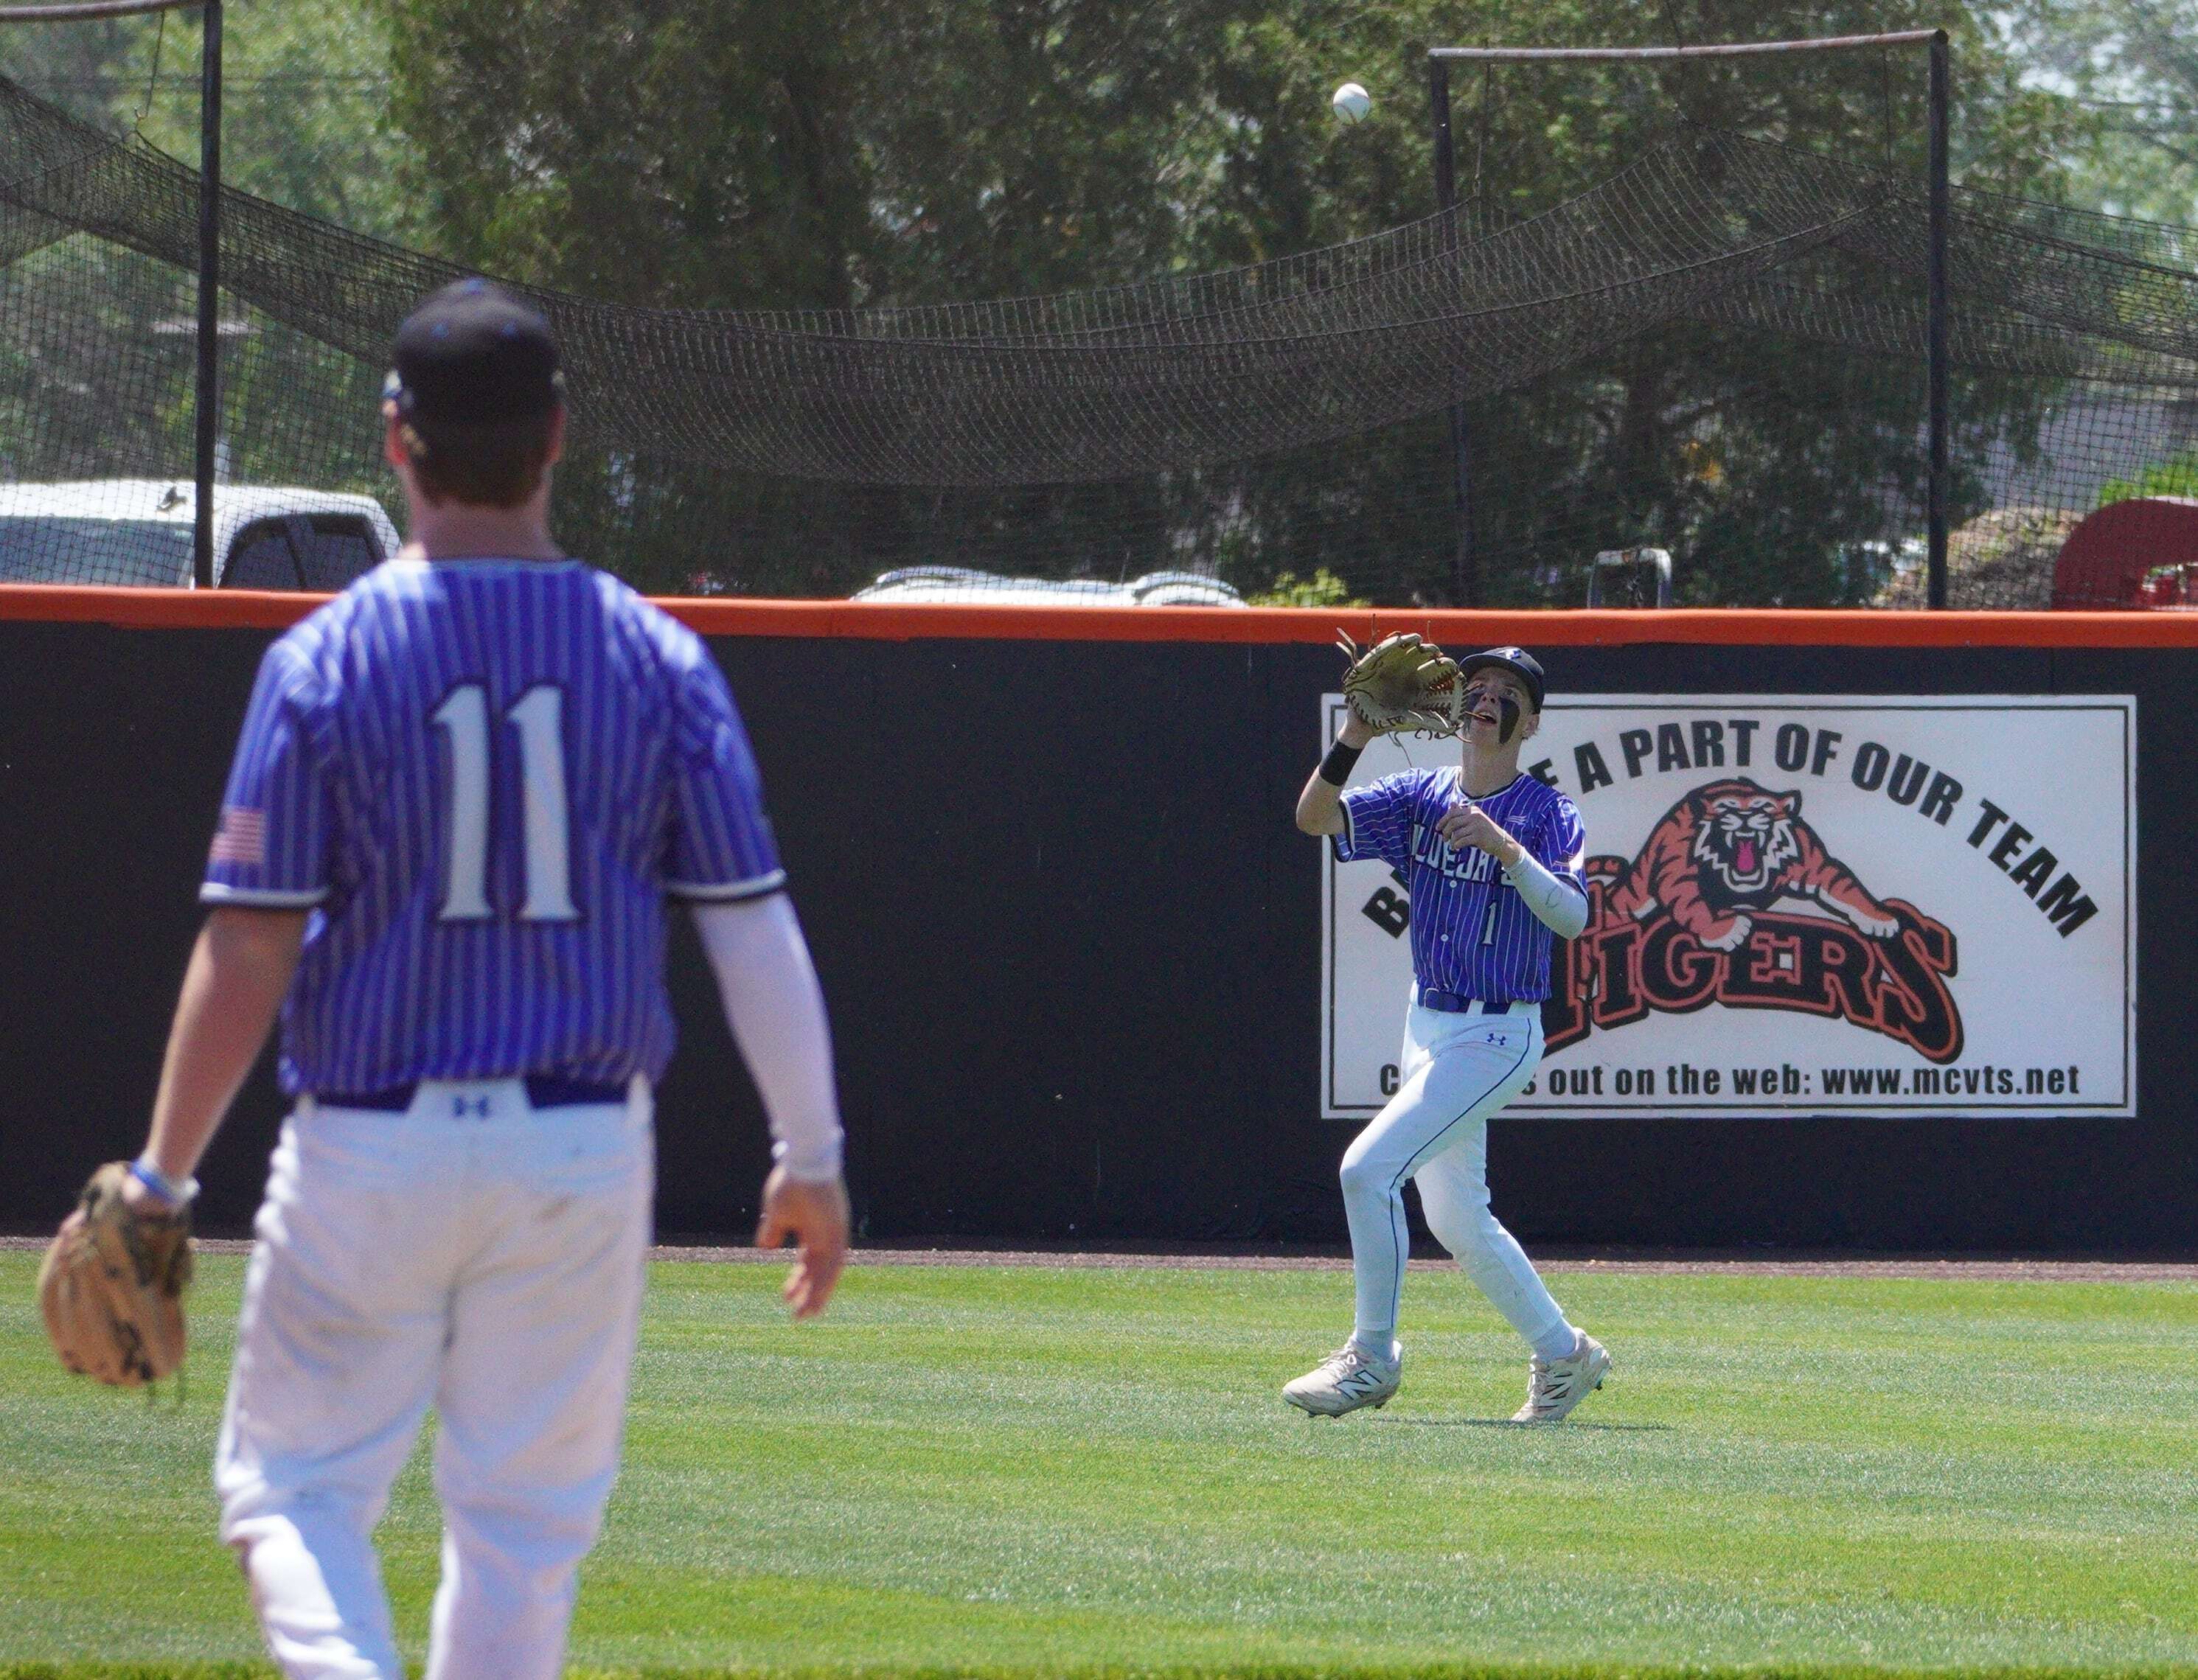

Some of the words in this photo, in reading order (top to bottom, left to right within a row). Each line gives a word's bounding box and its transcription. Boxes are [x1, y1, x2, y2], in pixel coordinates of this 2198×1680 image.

[432, 683, 582, 923] 11
[1573, 741, 1614, 794] A
[1619, 719, 1760, 778] PART
[1775, 723, 1843, 776] OF
[1851, 742, 1964, 826] OUR
[1966, 798, 2099, 938] TEAM
[1482, 900, 1498, 946] 1
[1548, 1065, 1604, 1096] out
[1615, 1068, 1655, 1095] on
[1666, 1063, 1721, 1095] the
[1732, 1063, 1811, 1095] web:
[1821, 1065, 2080, 1095] www.mcvts.net
